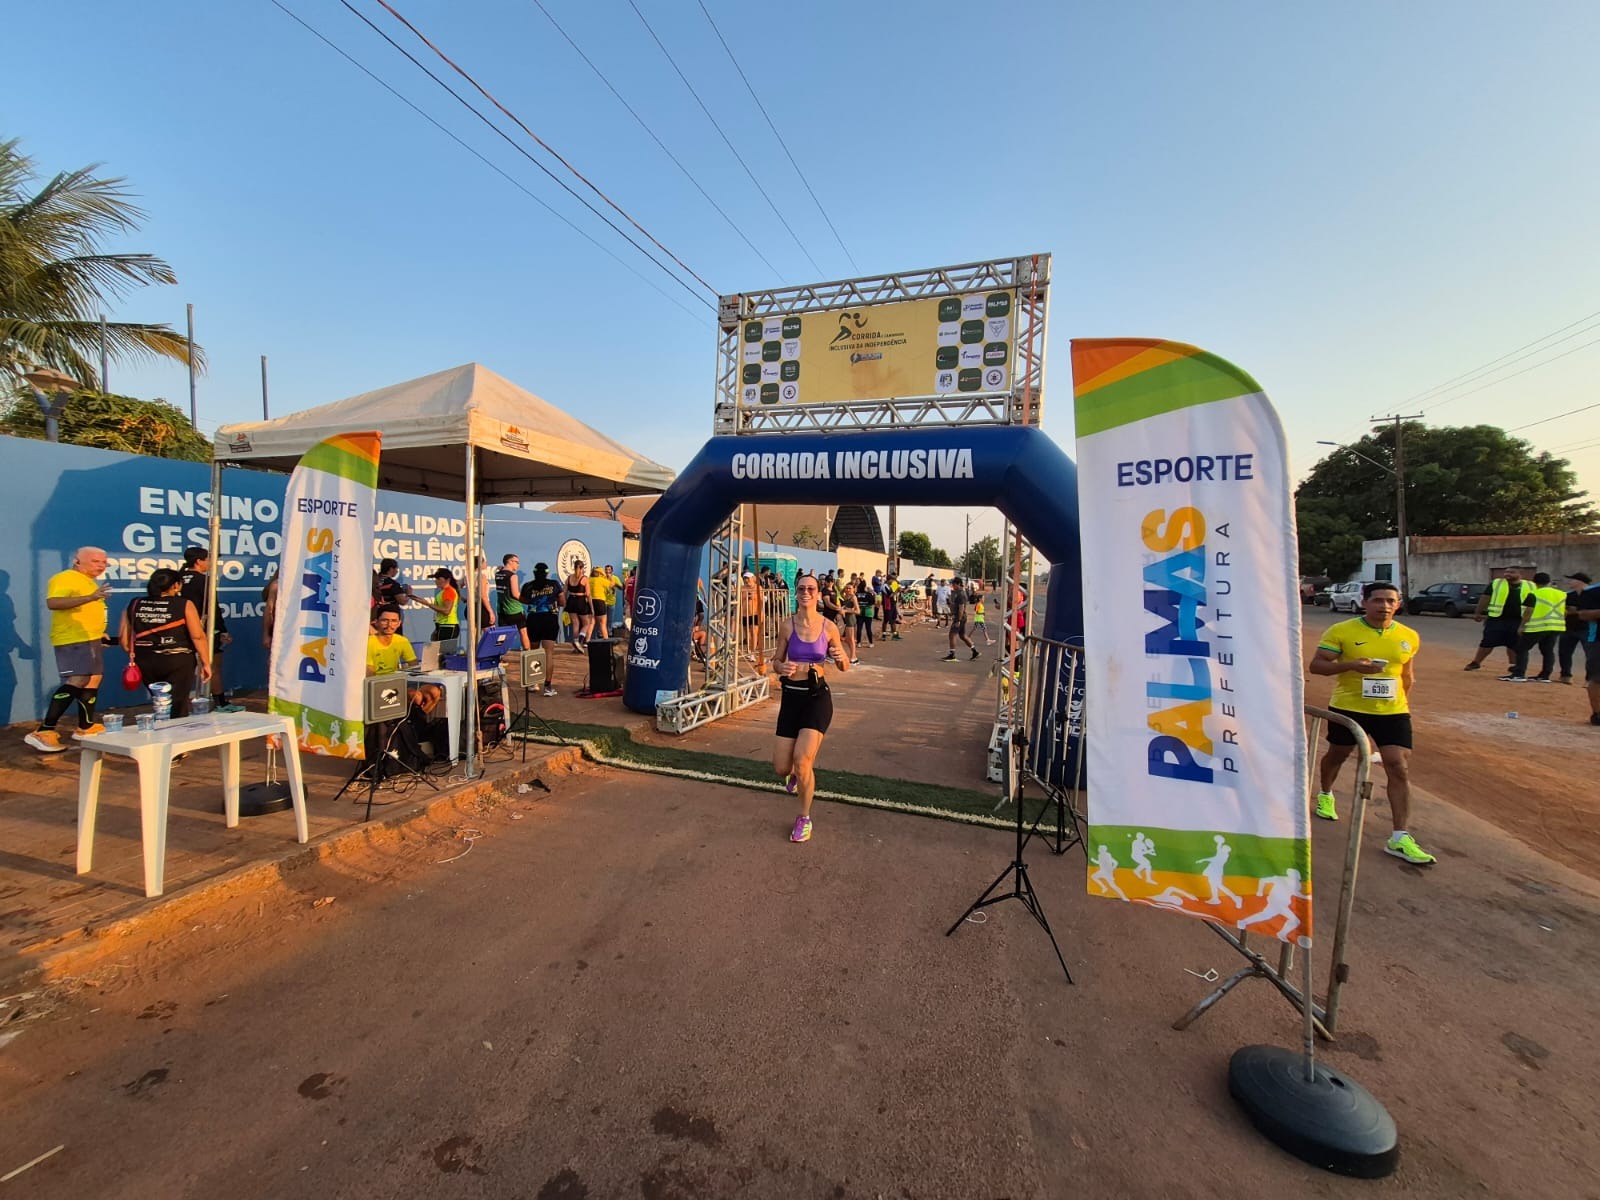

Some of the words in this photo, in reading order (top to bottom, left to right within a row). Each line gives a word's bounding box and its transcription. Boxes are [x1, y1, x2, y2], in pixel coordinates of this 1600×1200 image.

[731, 451, 830, 480] CORRIDA
[835, 447, 974, 480] INCLUSIVA
[1117, 453, 1254, 487] ESPORTE
[139, 486, 279, 523] ENSINO
[297, 498, 358, 518] ESPORTE
[122, 522, 283, 557] GESTÃO
[96, 557, 245, 581] RESPO
[297, 527, 335, 684] PALMAS
[329, 538, 342, 677] PREFEITURA
[1141, 505, 1214, 784] PALMAS
[1215, 522, 1239, 774] PREFEITURA
